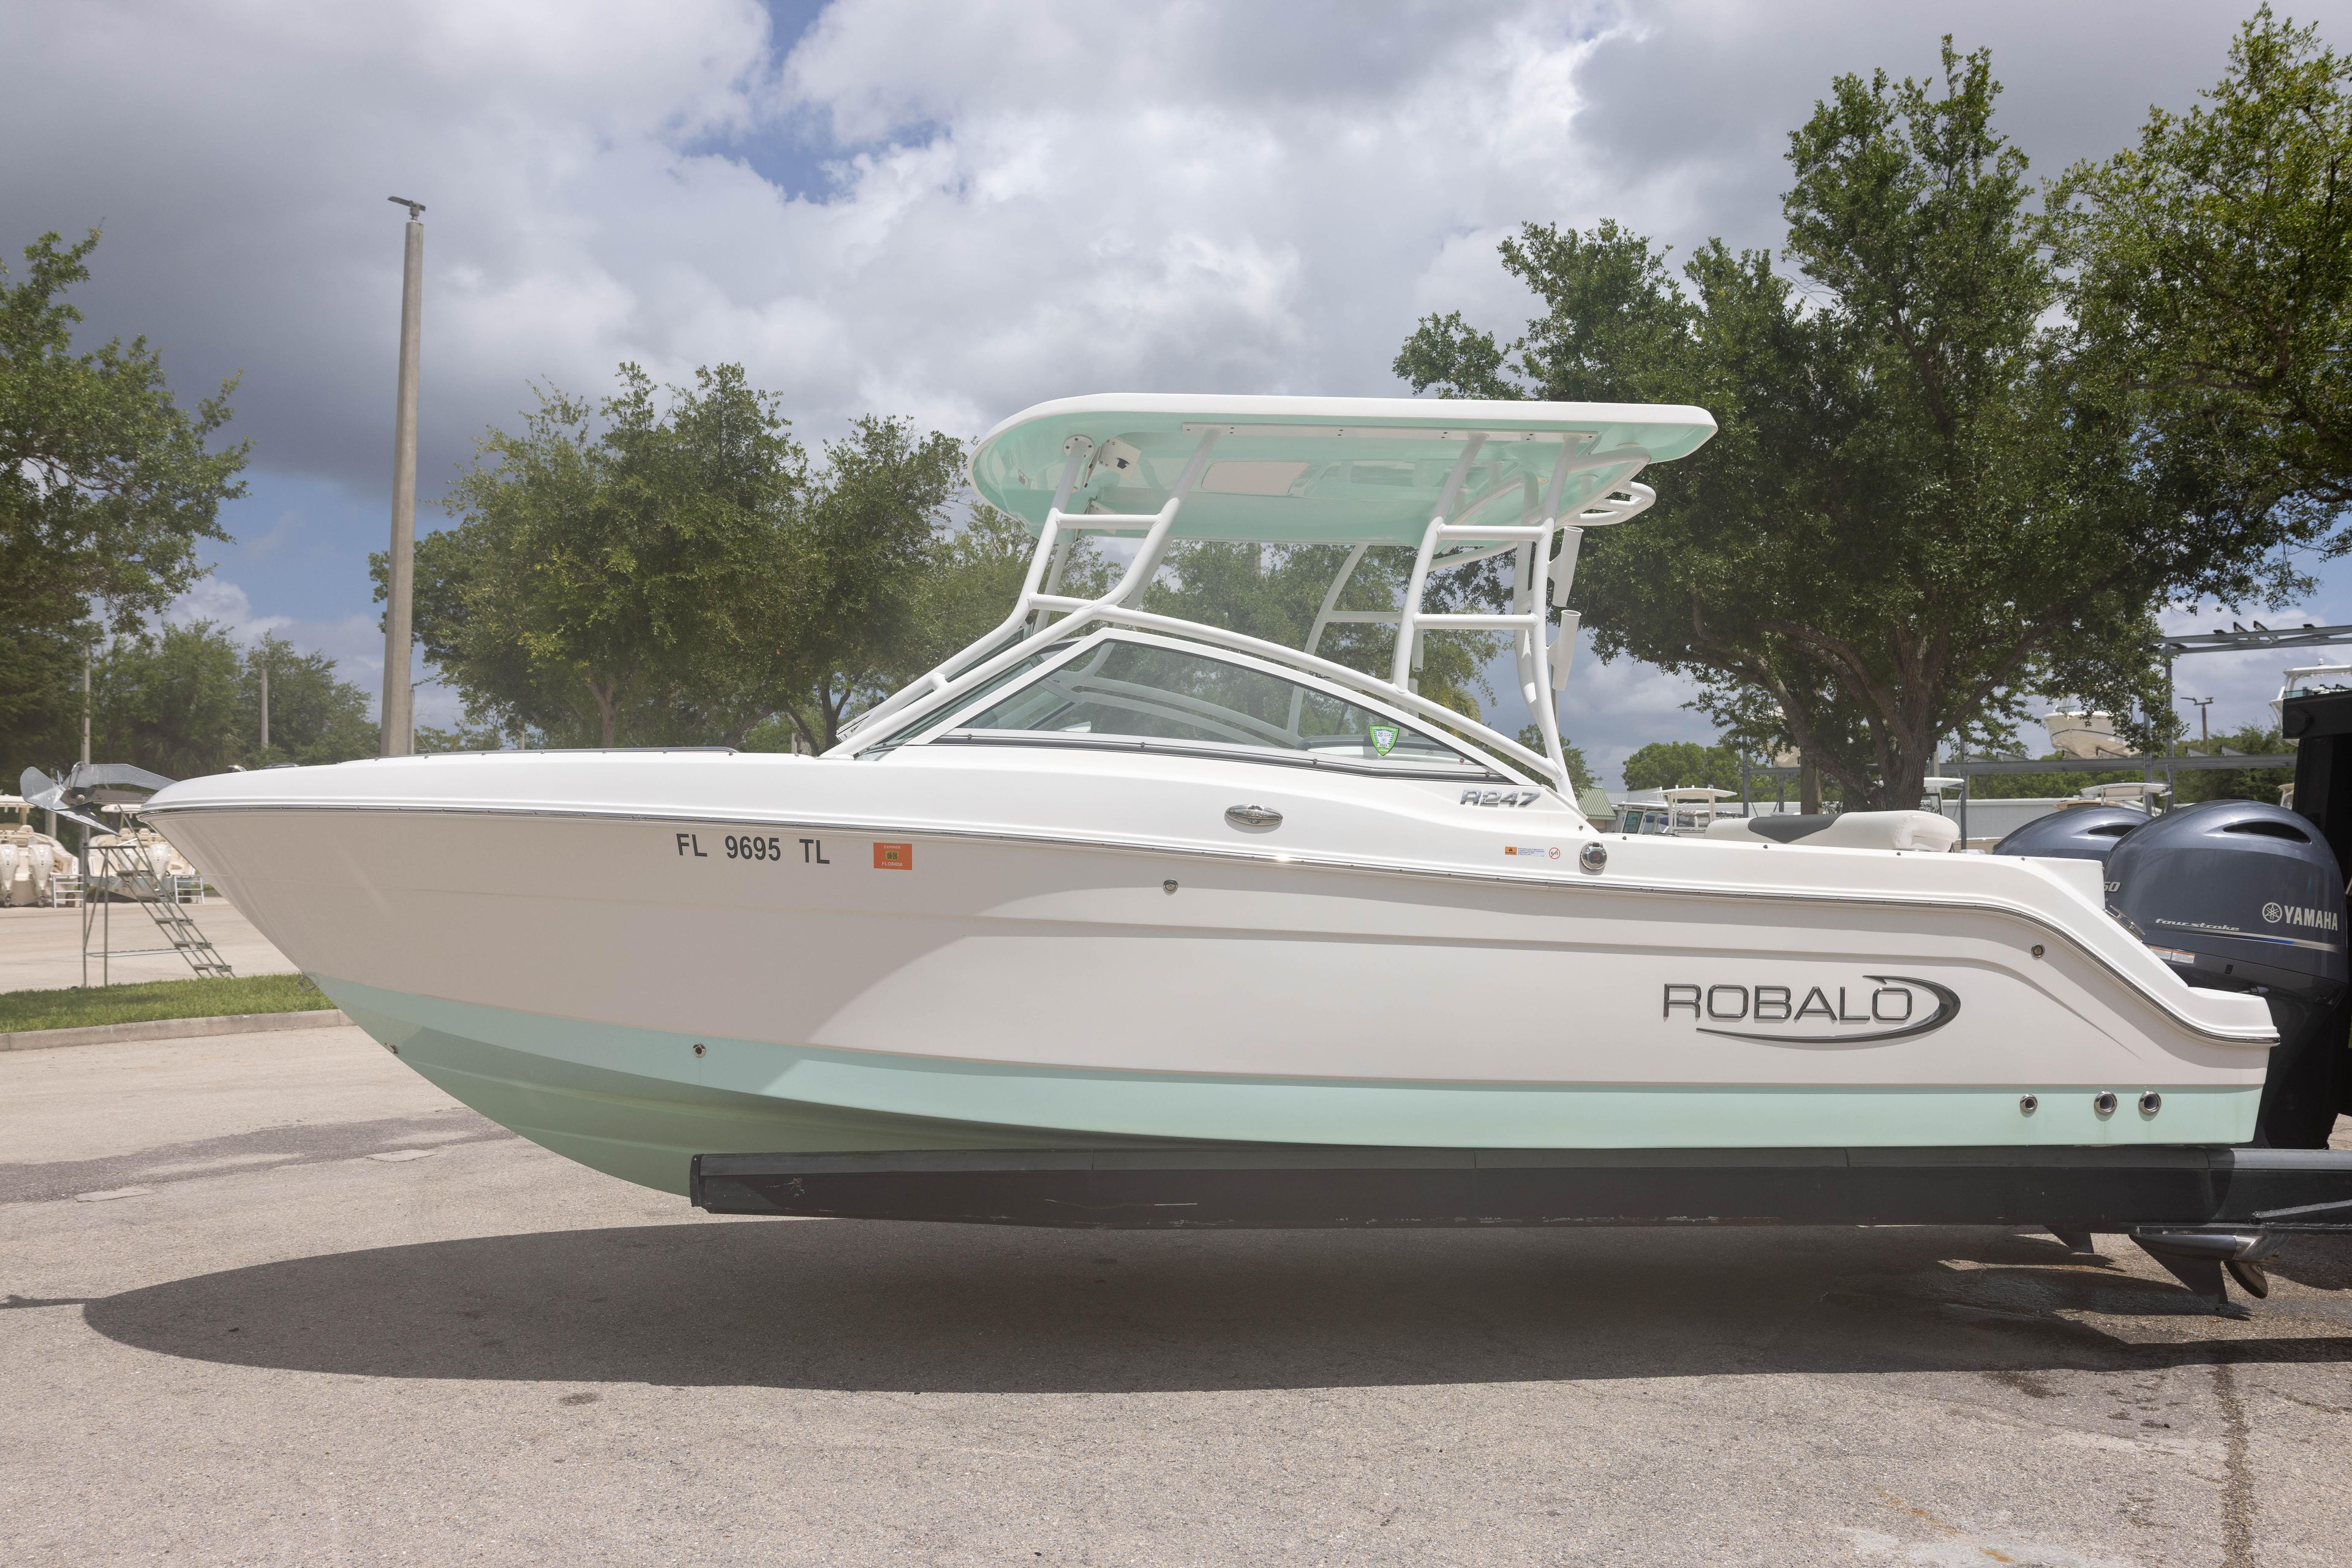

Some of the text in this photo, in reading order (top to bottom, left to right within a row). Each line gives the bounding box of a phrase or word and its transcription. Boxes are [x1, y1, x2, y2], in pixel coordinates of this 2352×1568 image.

[1460, 789, 1540, 807] R247
[676, 833, 830, 864] FL 9695 TL
[2284, 905, 2338, 931] YAMAHA
[1663, 983, 1912, 1021] ROBALO
